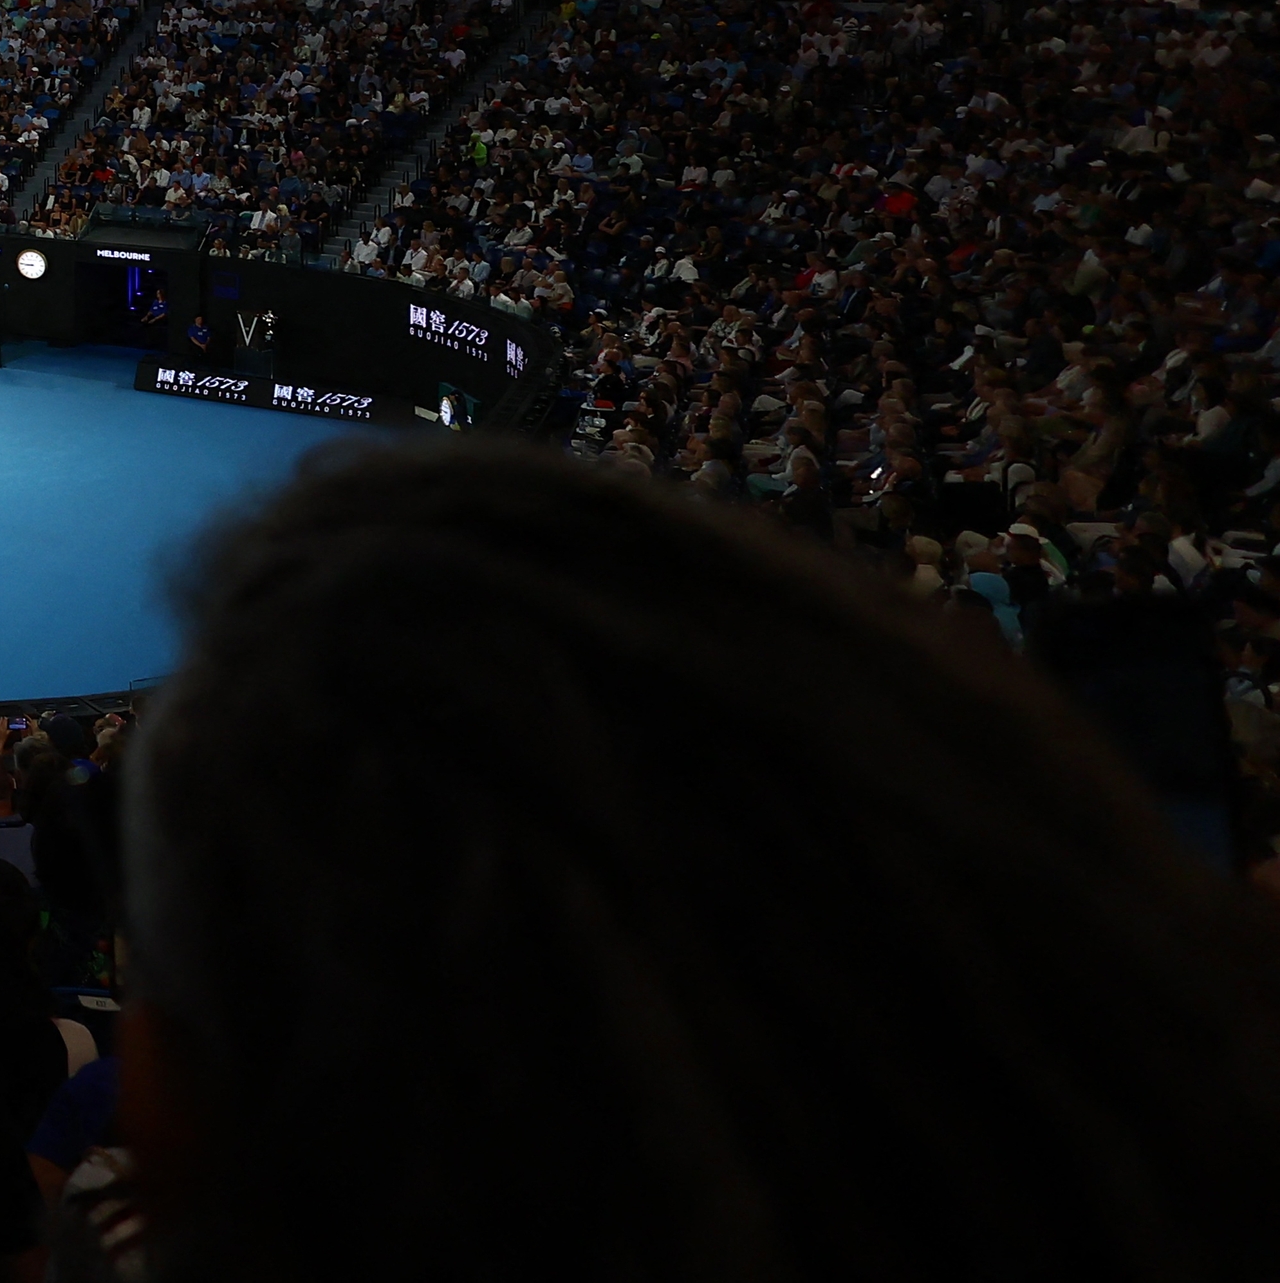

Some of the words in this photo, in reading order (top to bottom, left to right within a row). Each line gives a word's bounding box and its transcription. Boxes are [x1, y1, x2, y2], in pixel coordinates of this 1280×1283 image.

[96, 249, 151, 262] MELBOURNE
[409, 327, 459, 350] GUOJIAO
[466, 345, 488, 361] 1573
[155, 382, 209, 396] GUOJIAO
[218, 391, 246, 401] 1573
[272, 399, 330, 413] GUOJIAO
[340, 408, 371, 419] 1573
